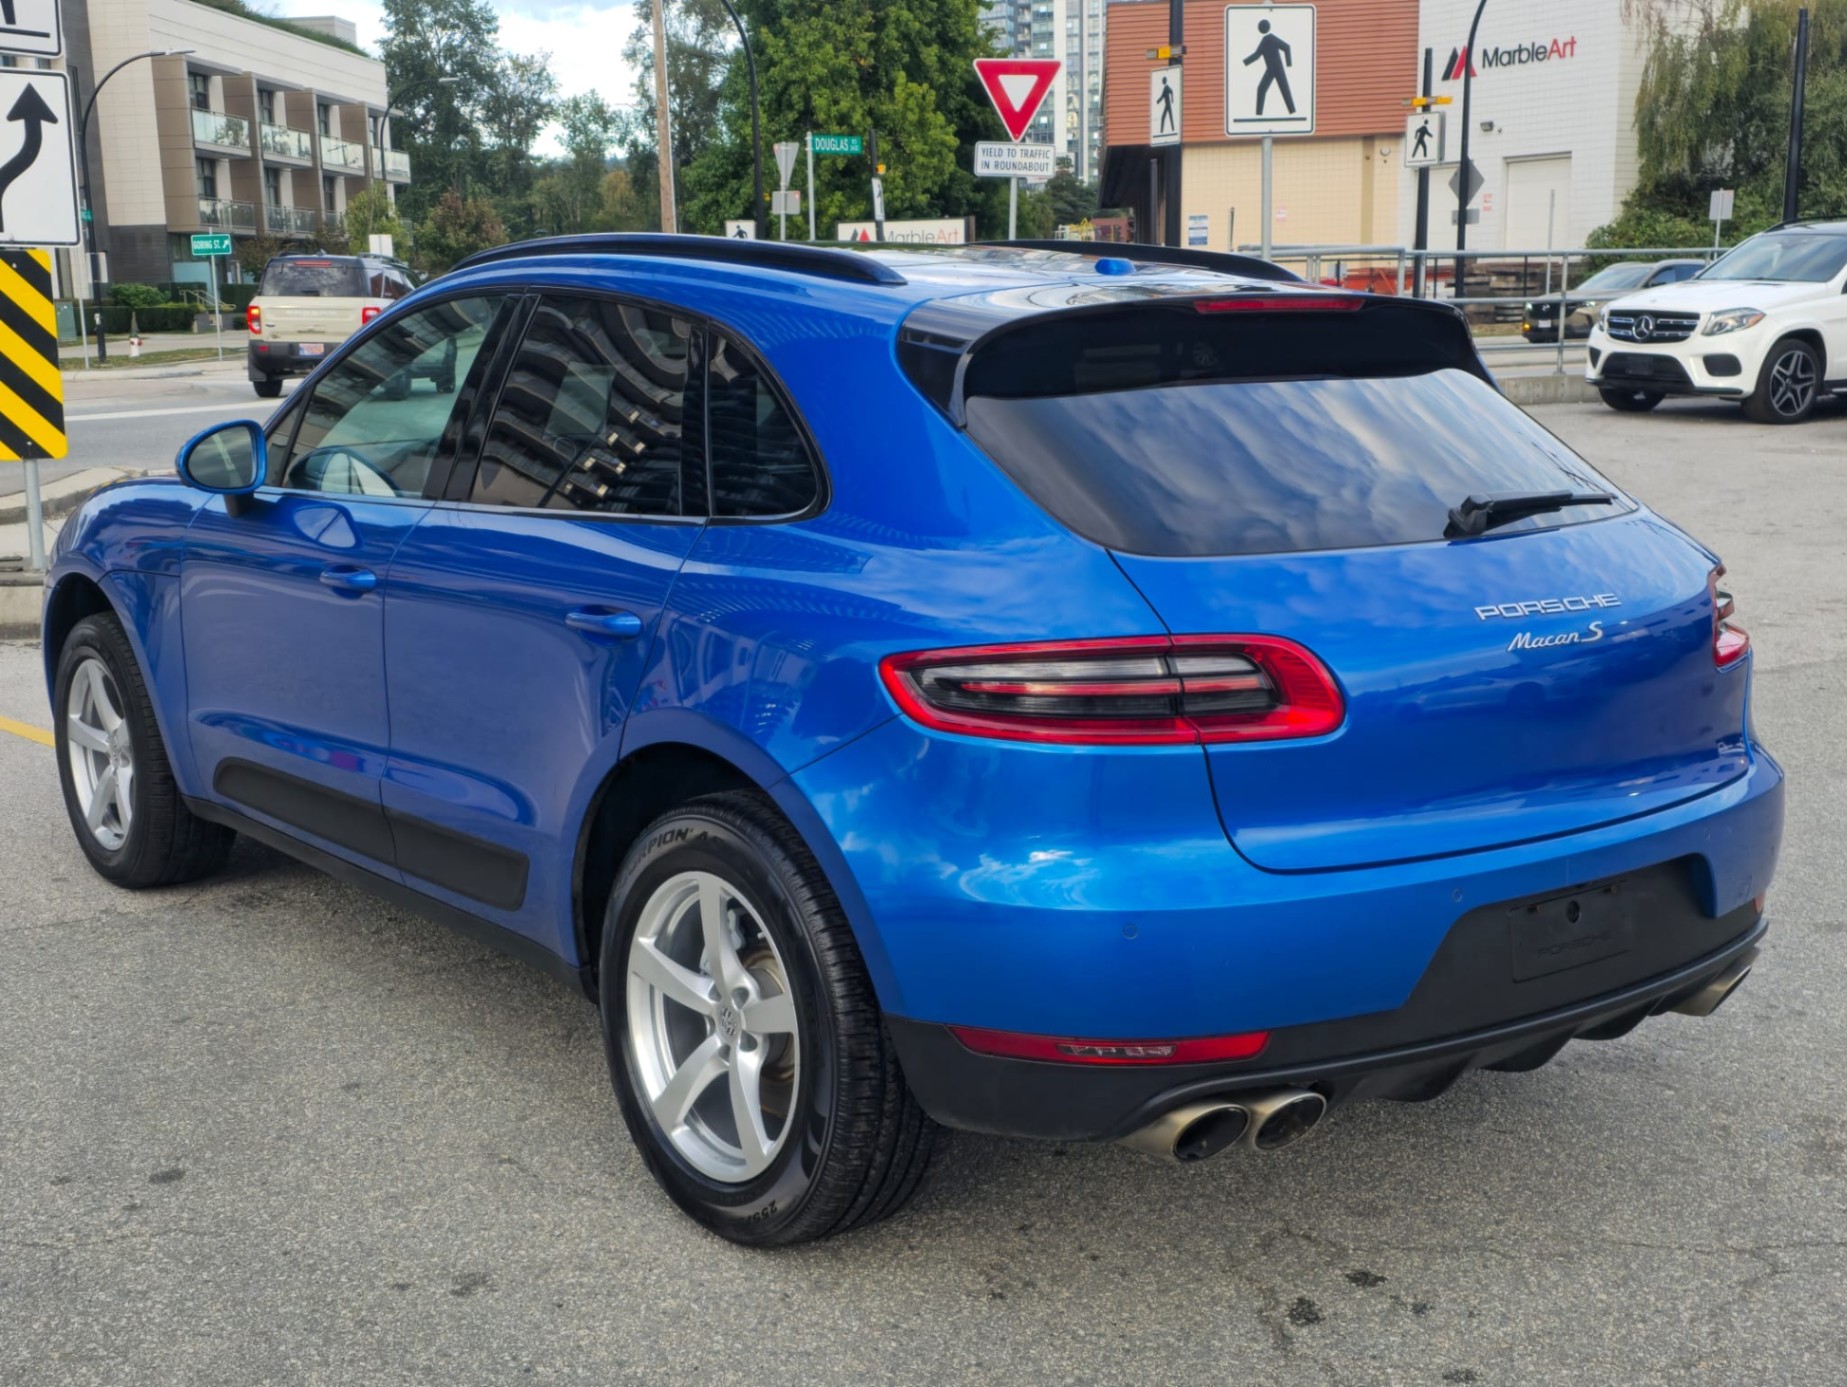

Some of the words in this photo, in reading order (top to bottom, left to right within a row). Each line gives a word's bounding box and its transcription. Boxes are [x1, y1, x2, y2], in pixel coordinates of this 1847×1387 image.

[1482, 36, 1576, 69] MarbleArt
[815, 137, 849, 151] DOUGLAS
[981, 147, 1003, 158] YIELD
[1007, 148, 1017, 158] TO
[1020, 149, 1050, 160] TRAFFIC
[981, 160, 990, 170] IN
[994, 161, 1049, 172] ROUNDABOUT
[1474, 593, 1622, 621] PORSCHE
[1507, 631, 1580, 651] Macan
[1581, 620, 1604, 642] S
